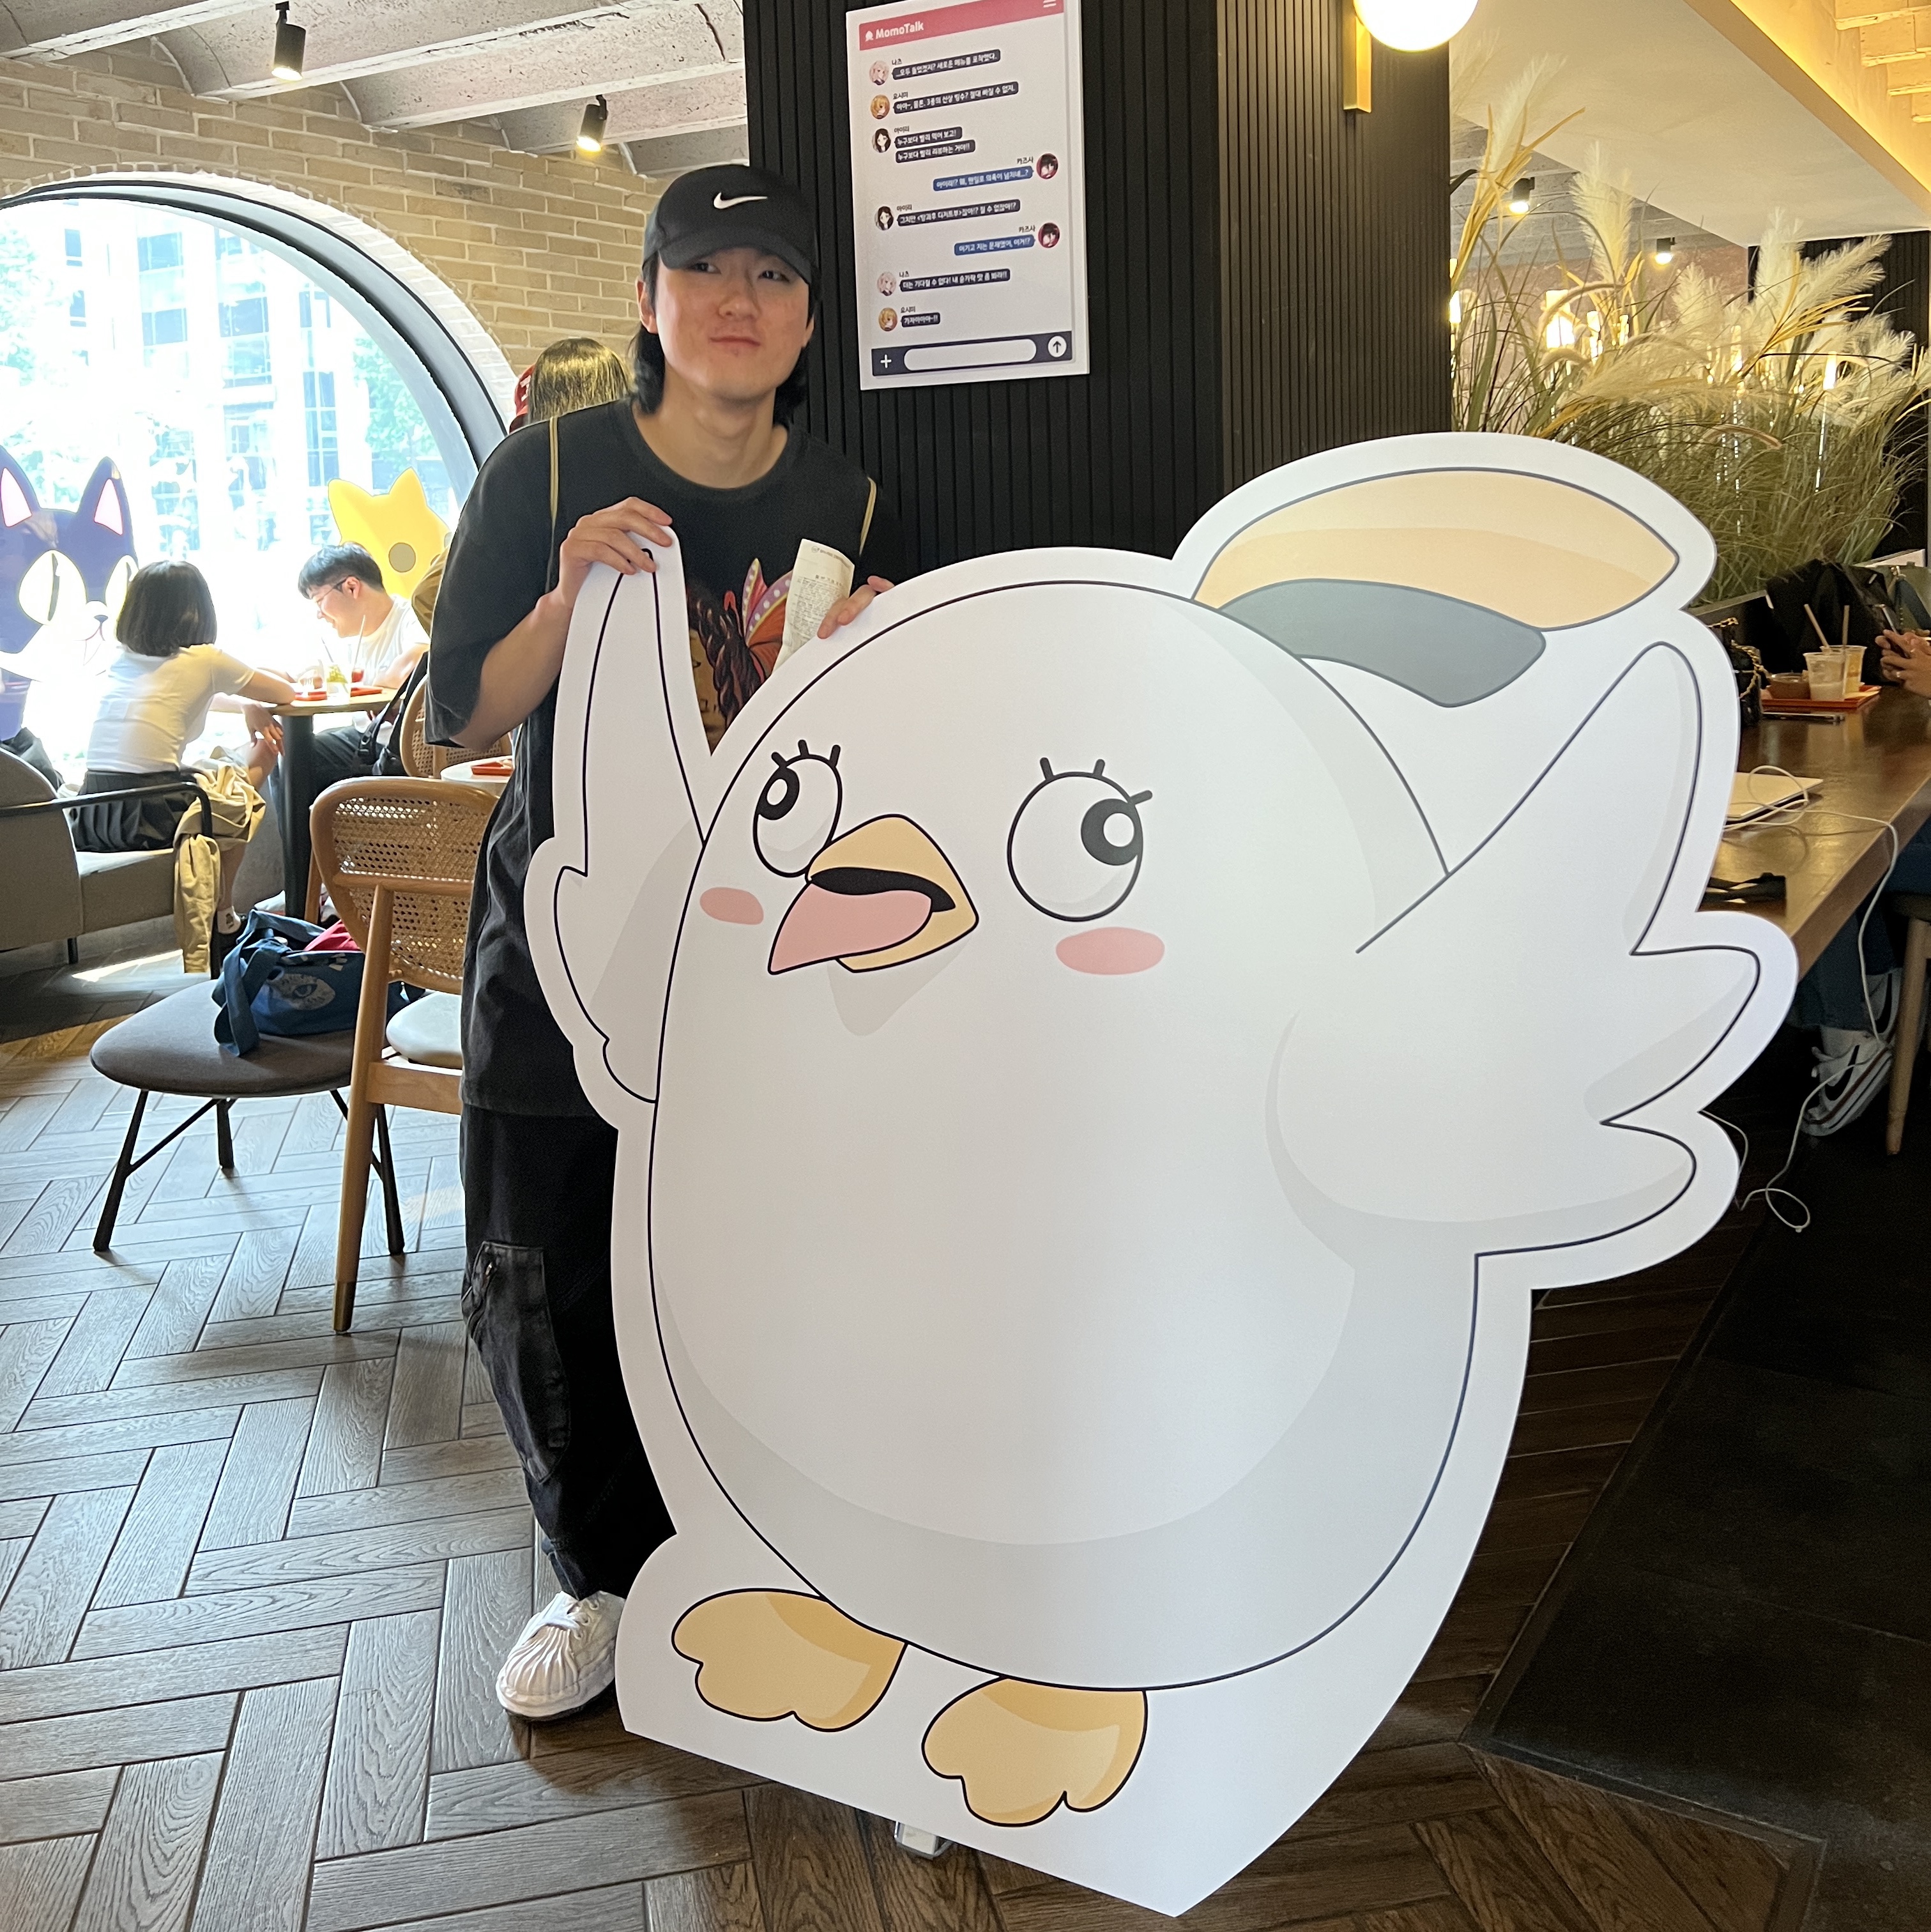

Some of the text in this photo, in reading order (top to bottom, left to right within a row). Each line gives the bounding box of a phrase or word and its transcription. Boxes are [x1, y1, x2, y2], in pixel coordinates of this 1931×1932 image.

[876, 21, 924, 39] MomoTalk
[937, 58, 952, 68] 새로운
[954, 57, 970, 67] 메뉴를
[893, 91, 908, 100] 요시미
[927, 96, 940, 106] 3종의
[942, 95, 952, 103] 신상
[954, 91, 968, 102] 빙수?
[970, 89, 981, 99] 절대
[982, 88, 993, 96] 빠질
[894, 125, 909, 134] 아이리
[897, 129, 956, 146] 누구보다 빨리 먹어 보고!
[897, 151, 918, 160] 누구보다
[920, 149, 931, 157] 빨리
[932, 145, 953, 155] 리뷰하는
[1017, 156, 1034, 165] 카즈사
[986, 172, 1002, 181] 의욕이
[900, 215, 915, 224] 그치만
[980, 206, 985, 214] 질
[959, 243, 974, 252] 이기고
[977, 242, 987, 251] 지는
[903, 280, 913, 289] 더는
[915, 279, 930, 288] 기다릴
[938, 277, 950, 285] 없다!
[959, 274, 975, 283] 숟가락
[984, 272, 989, 280] 좀
